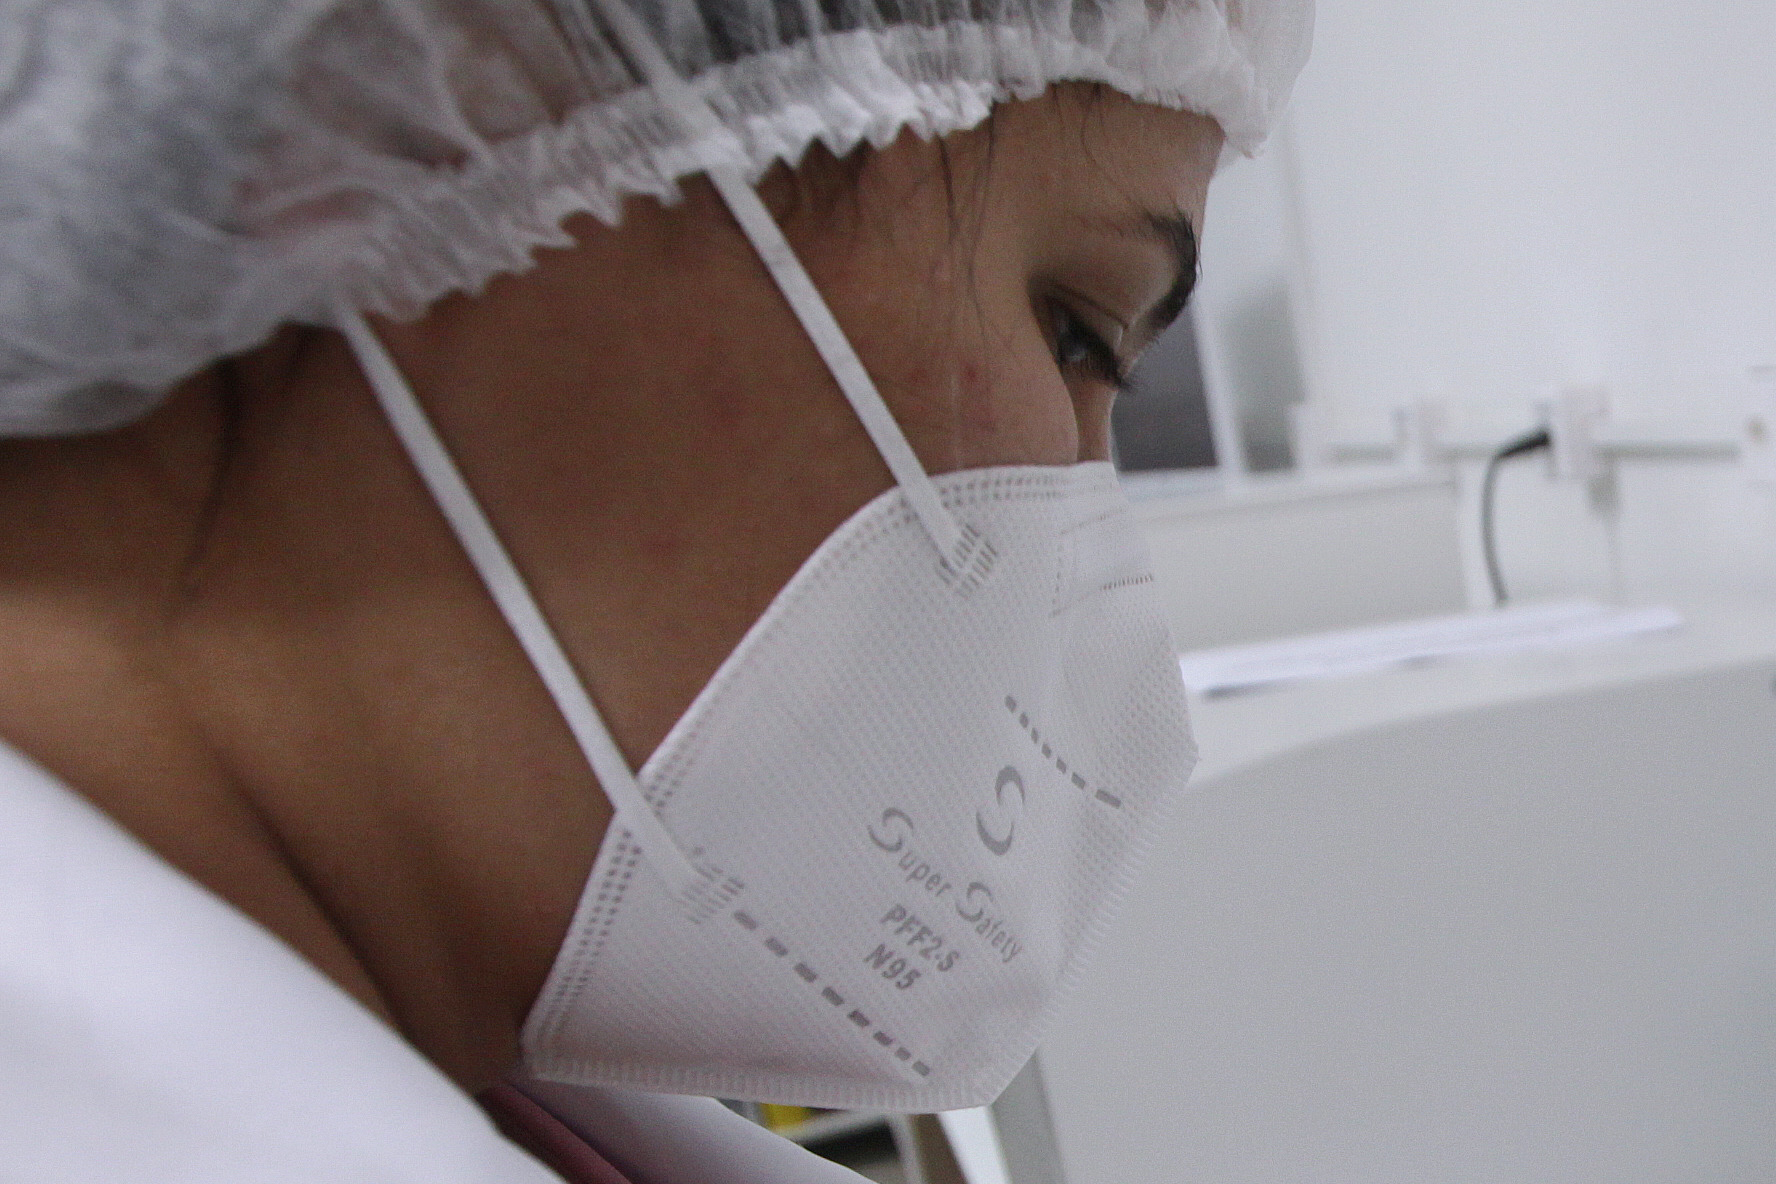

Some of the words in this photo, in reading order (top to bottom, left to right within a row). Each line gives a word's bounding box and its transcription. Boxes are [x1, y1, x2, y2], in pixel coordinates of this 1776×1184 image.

[867, 806, 953, 897] Super
[956, 880, 1024, 963] Safety
[863, 943, 922, 990] N95
